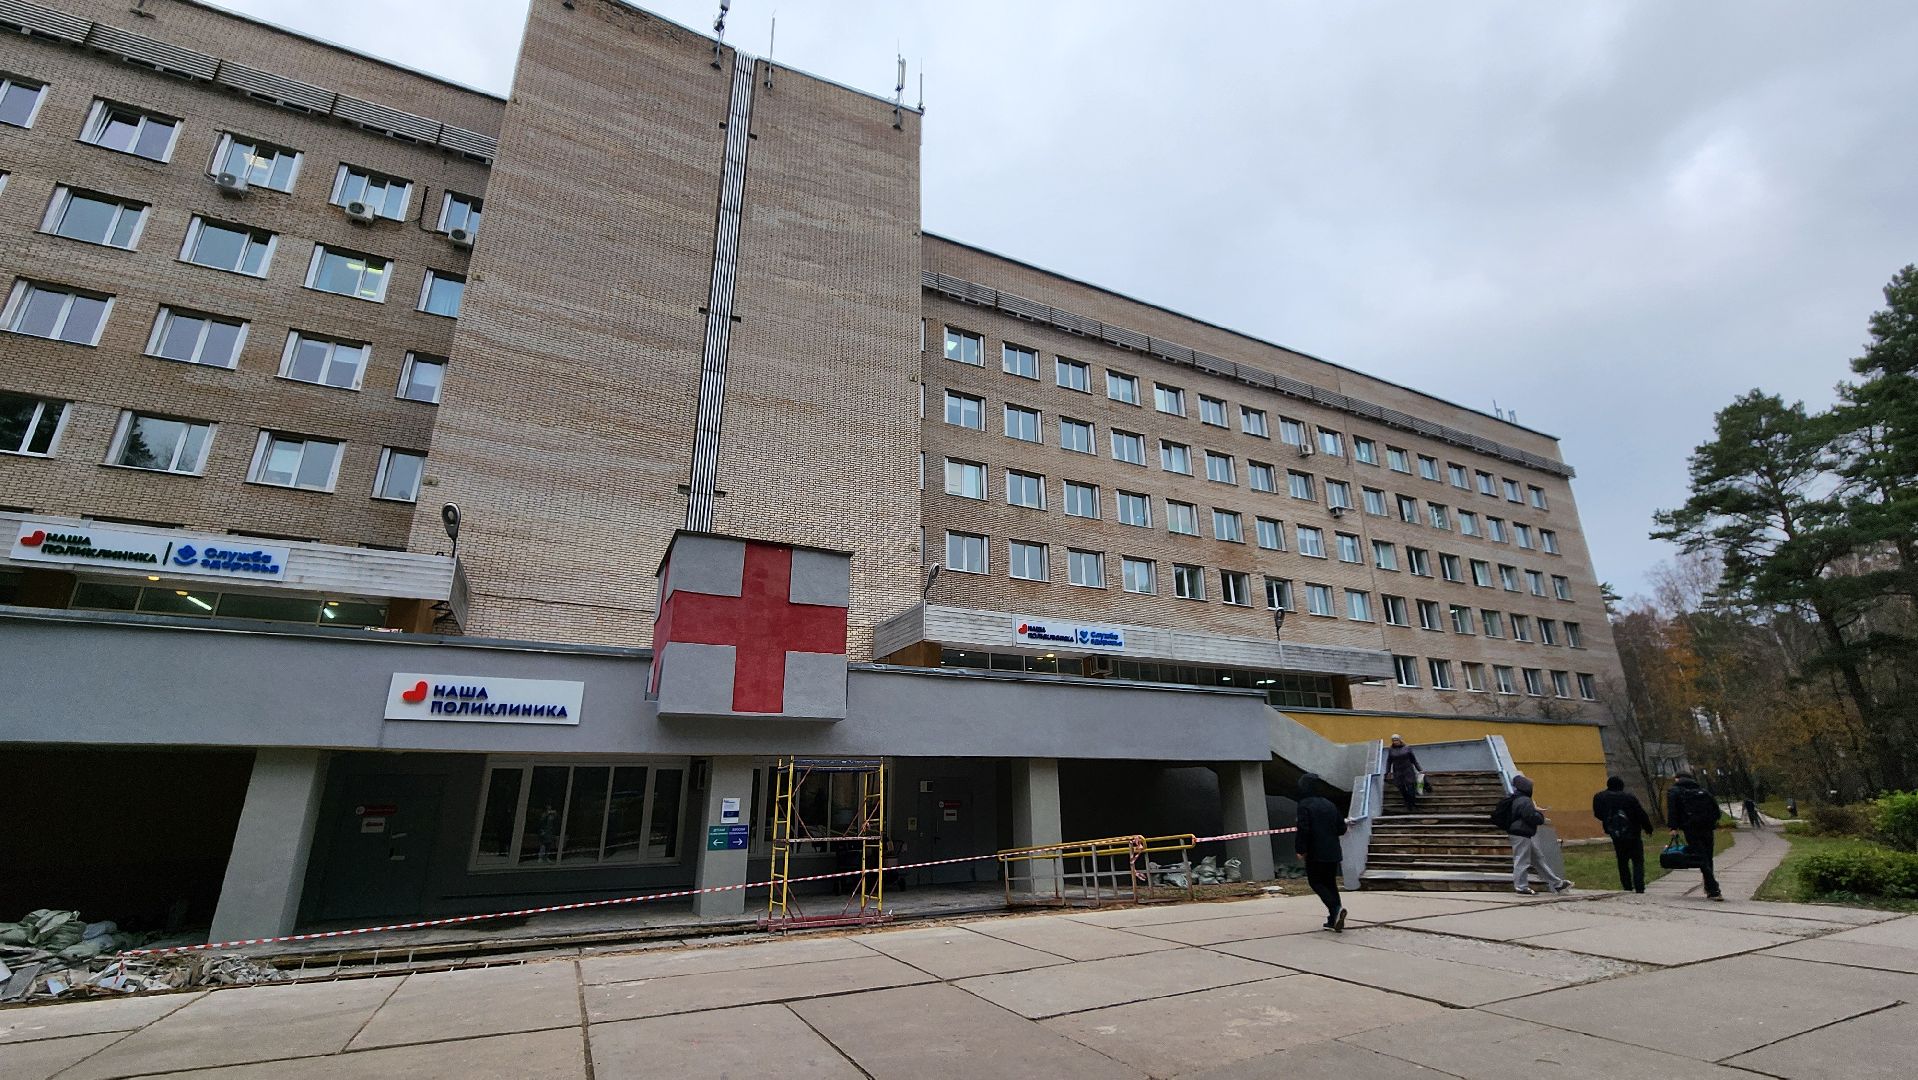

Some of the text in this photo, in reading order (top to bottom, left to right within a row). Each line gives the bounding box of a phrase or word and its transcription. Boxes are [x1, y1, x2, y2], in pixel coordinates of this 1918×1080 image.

[45, 532, 92, 546] НАША
[41, 543, 157, 563] ПОЛИКЛИНИКА
[204, 547, 272, 563] Служба
[200, 559, 279, 574] здоровья
[433, 684, 488, 699] НАША
[430, 700, 568, 718] ПОЛИКЛИНИКА
